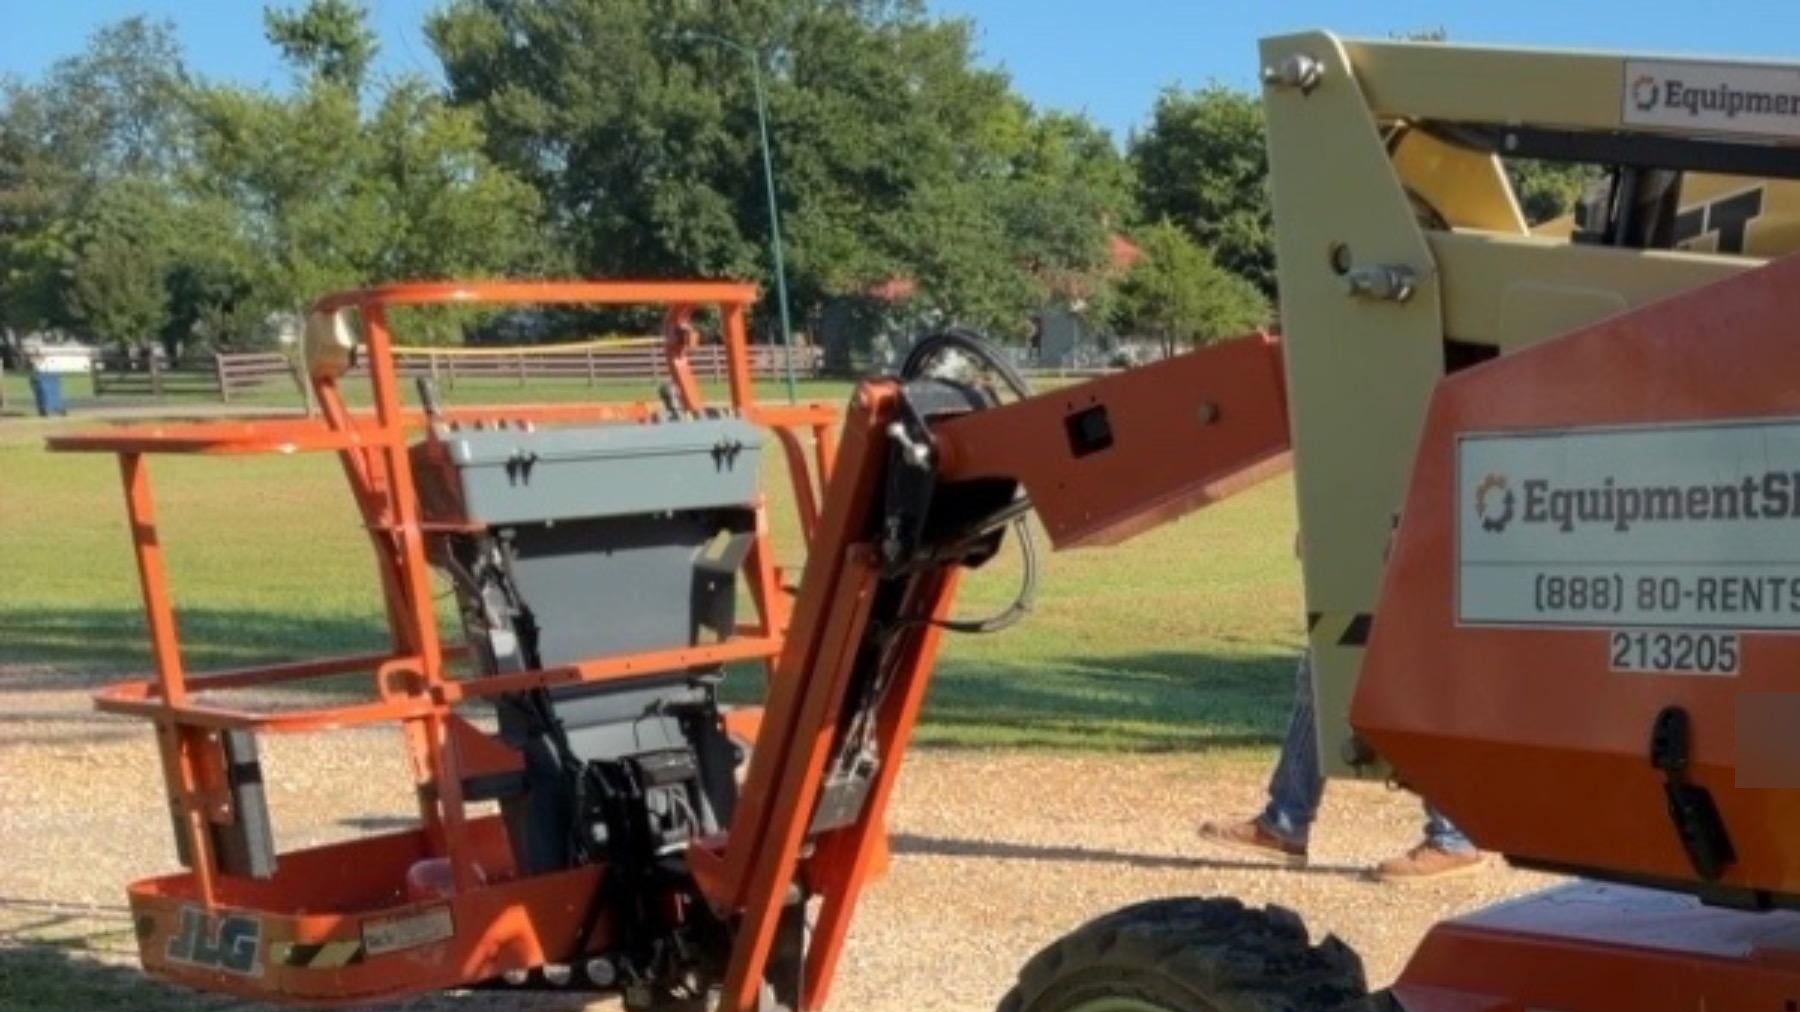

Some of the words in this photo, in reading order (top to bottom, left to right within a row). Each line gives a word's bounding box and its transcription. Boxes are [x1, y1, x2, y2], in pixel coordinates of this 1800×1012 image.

[1535, 573, 1624, 614] (888)
[1612, 631, 1739, 673] 213205
[167, 904, 262, 977] JLG
